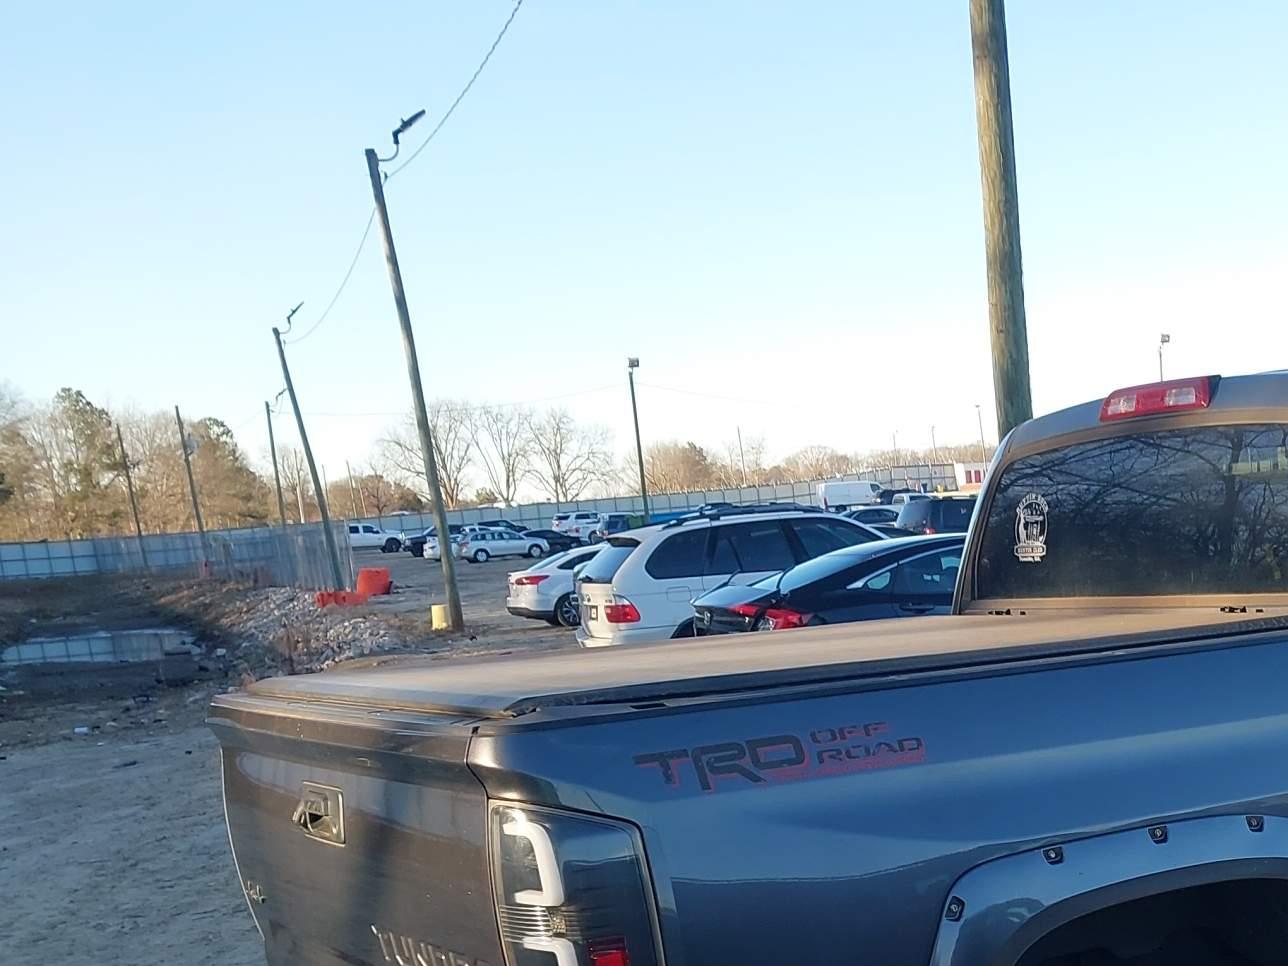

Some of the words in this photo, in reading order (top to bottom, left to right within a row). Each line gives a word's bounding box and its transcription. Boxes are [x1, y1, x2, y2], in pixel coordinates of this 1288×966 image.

[809, 721, 889, 745] OFF
[632, 734, 807, 793] TRD
[815, 737, 925, 768] ROAD
